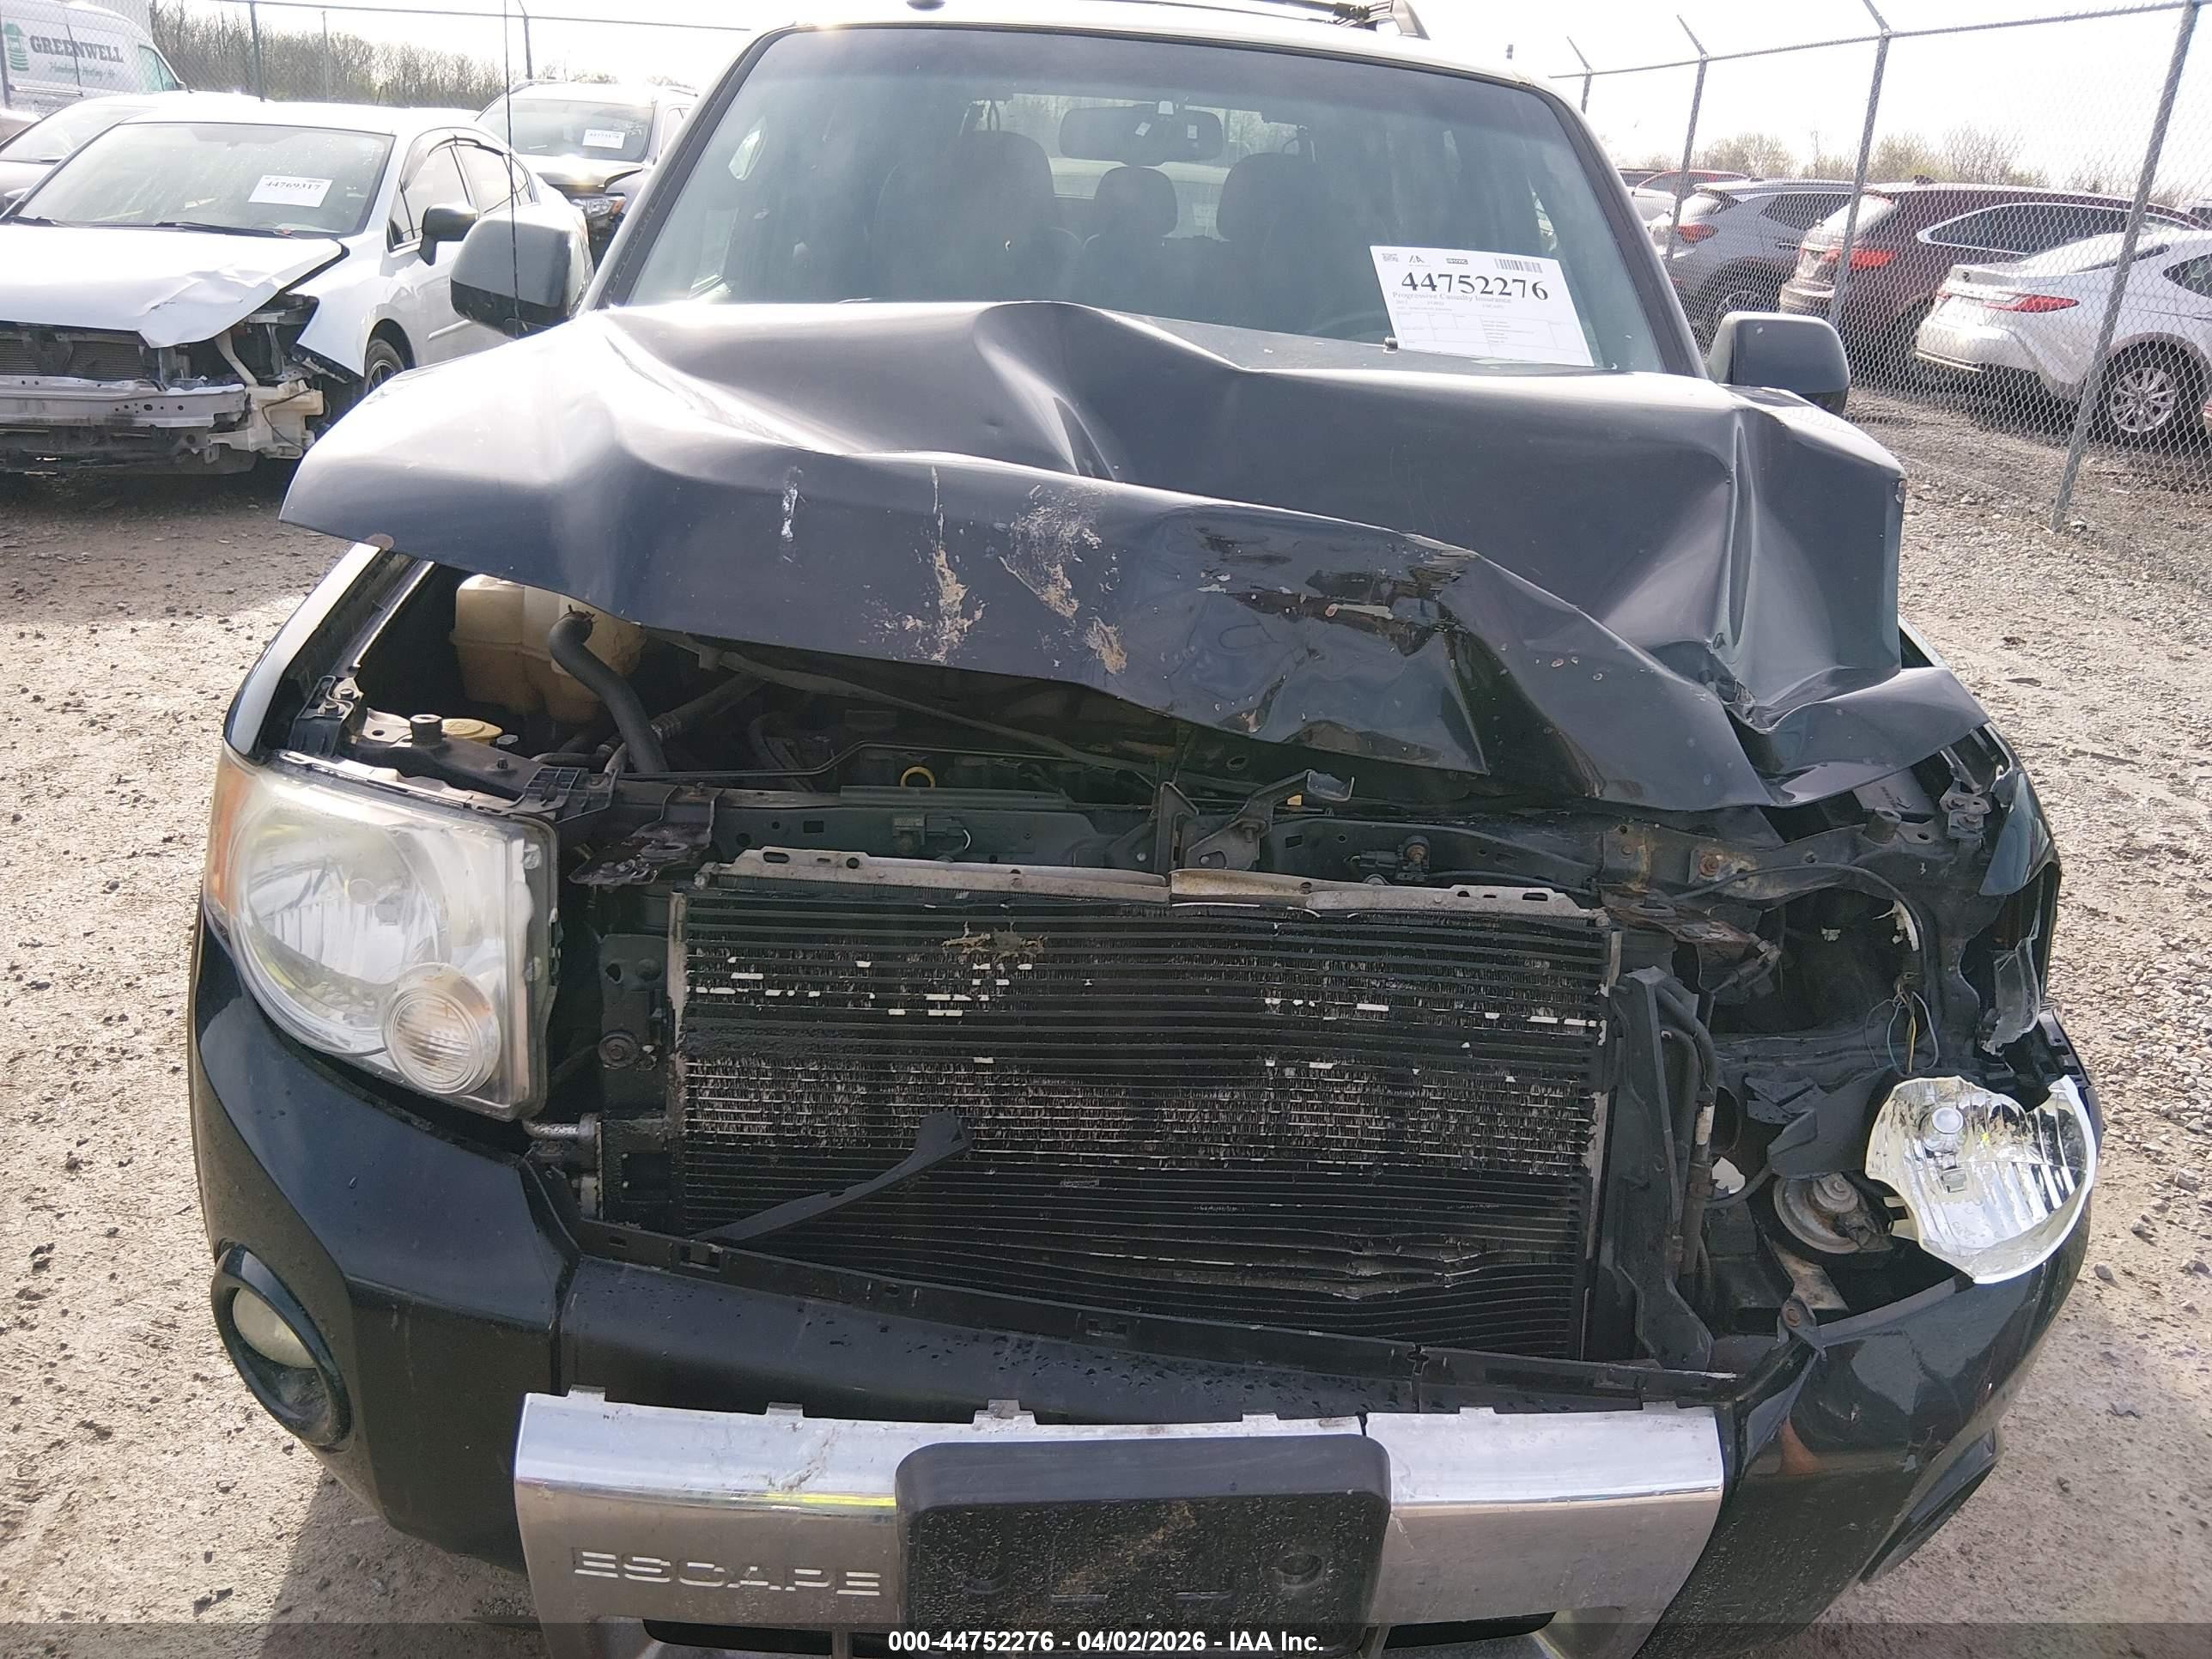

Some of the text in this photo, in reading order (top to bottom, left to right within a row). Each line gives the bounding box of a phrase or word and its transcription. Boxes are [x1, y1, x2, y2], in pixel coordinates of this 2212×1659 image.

[29, 35, 125, 63] GREENWELL
[1401, 271, 1549, 301] 44752276
[573, 1548, 882, 1596] ESCAPE
